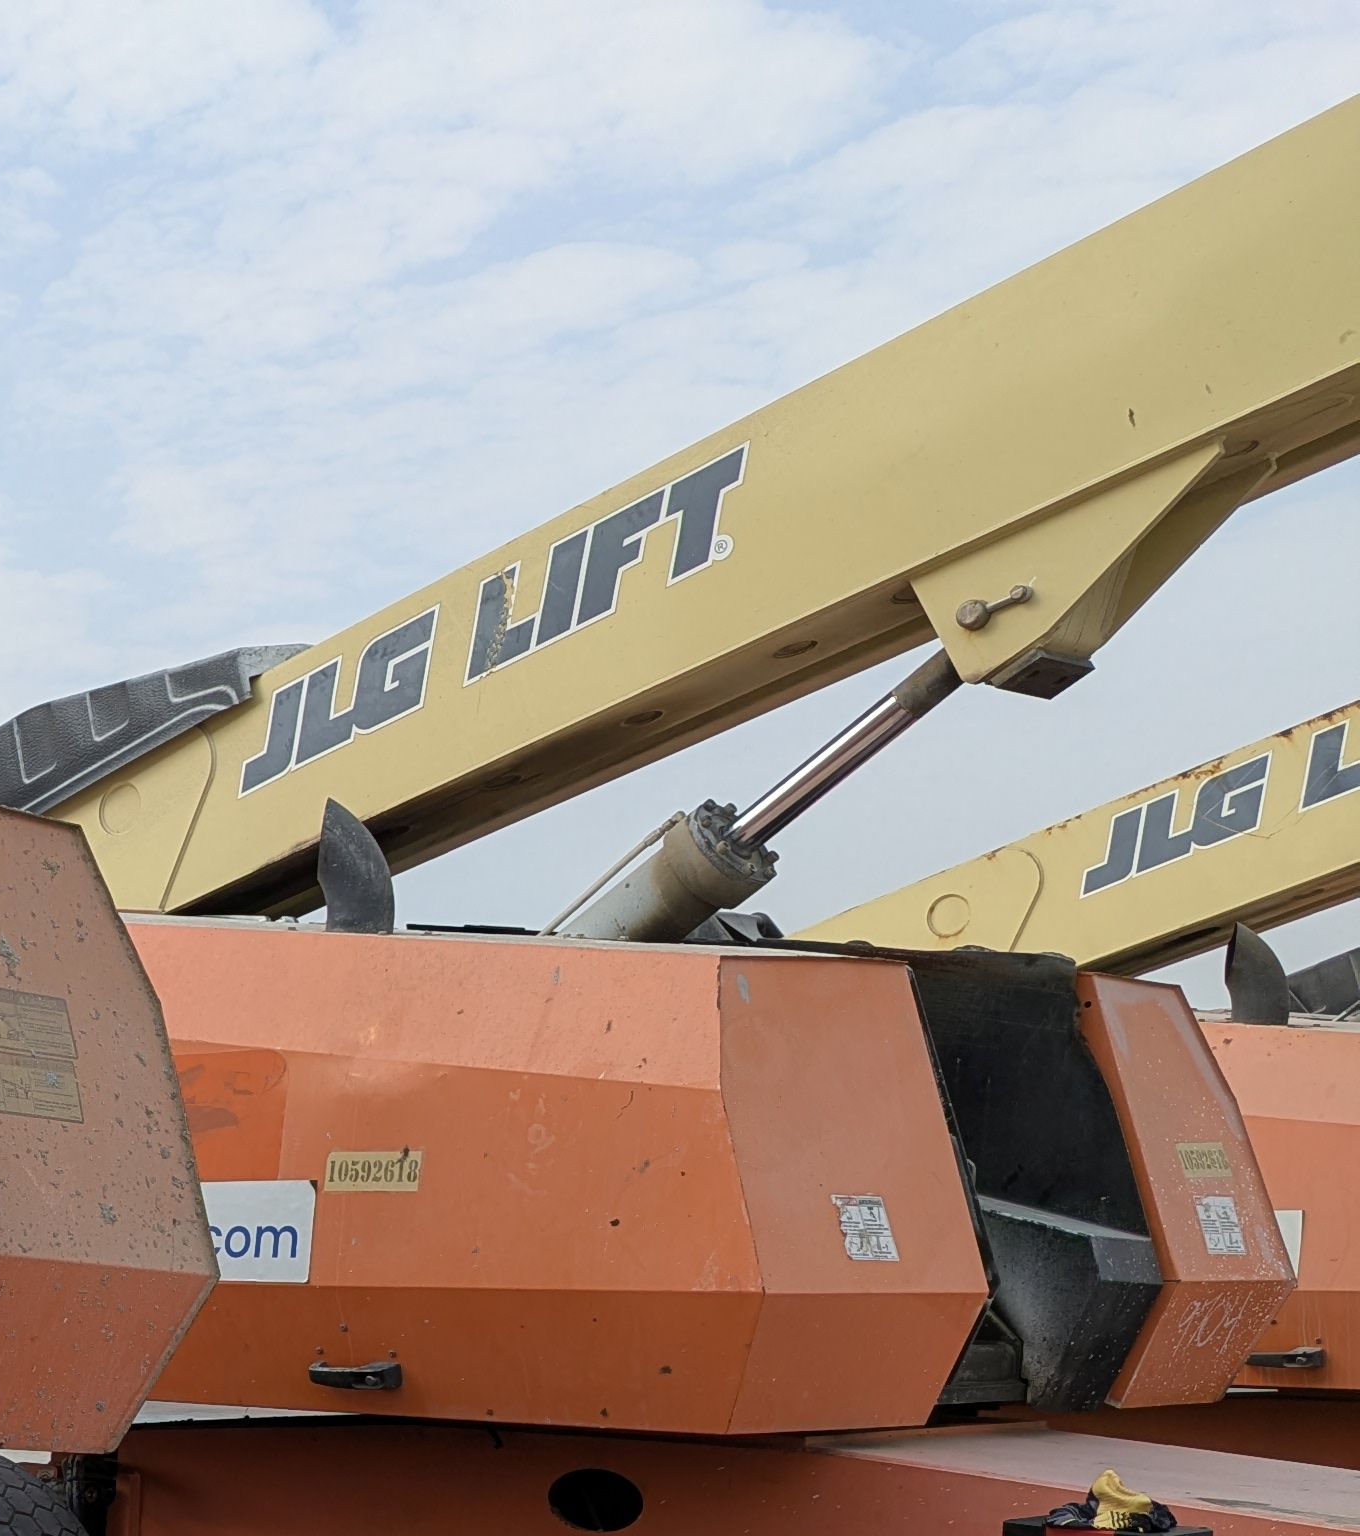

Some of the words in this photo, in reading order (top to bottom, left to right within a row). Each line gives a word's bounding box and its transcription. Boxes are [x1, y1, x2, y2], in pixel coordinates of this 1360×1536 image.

[238, 603, 440, 799] JLG
[1080, 750, 1273, 900] JLG
[328, 1159, 419, 1183] 10592618
